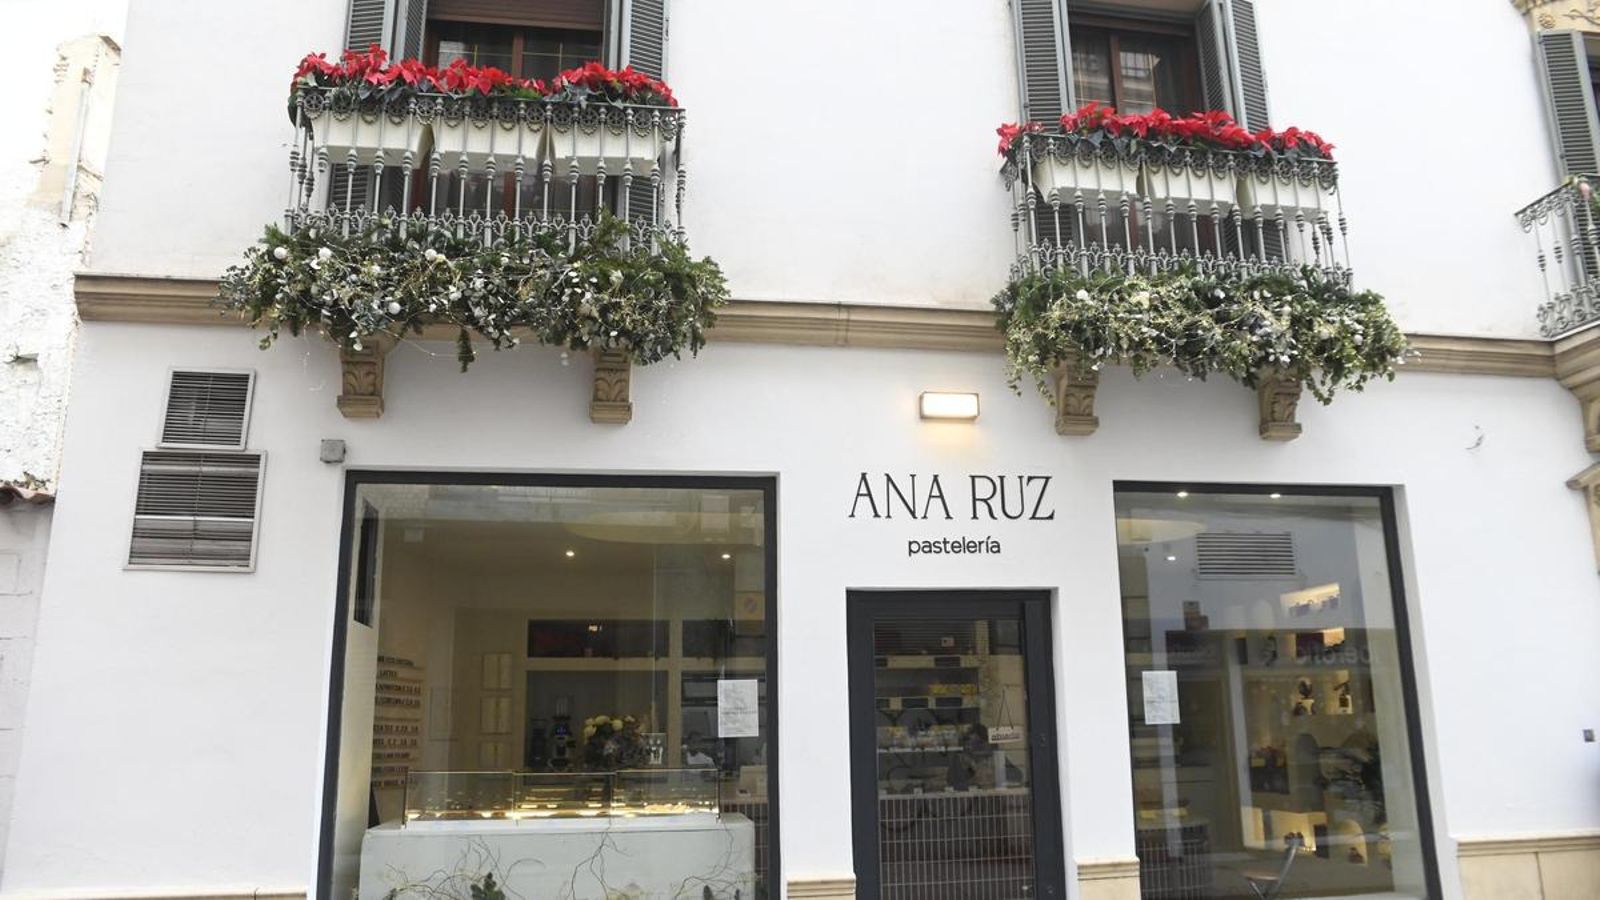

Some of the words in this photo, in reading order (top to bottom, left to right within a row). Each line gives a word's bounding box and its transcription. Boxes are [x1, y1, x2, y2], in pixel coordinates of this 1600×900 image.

[849, 473, 953, 519] ANA
[969, 475, 1055, 520] RUZ
[909, 536, 1000, 556] pastelería
